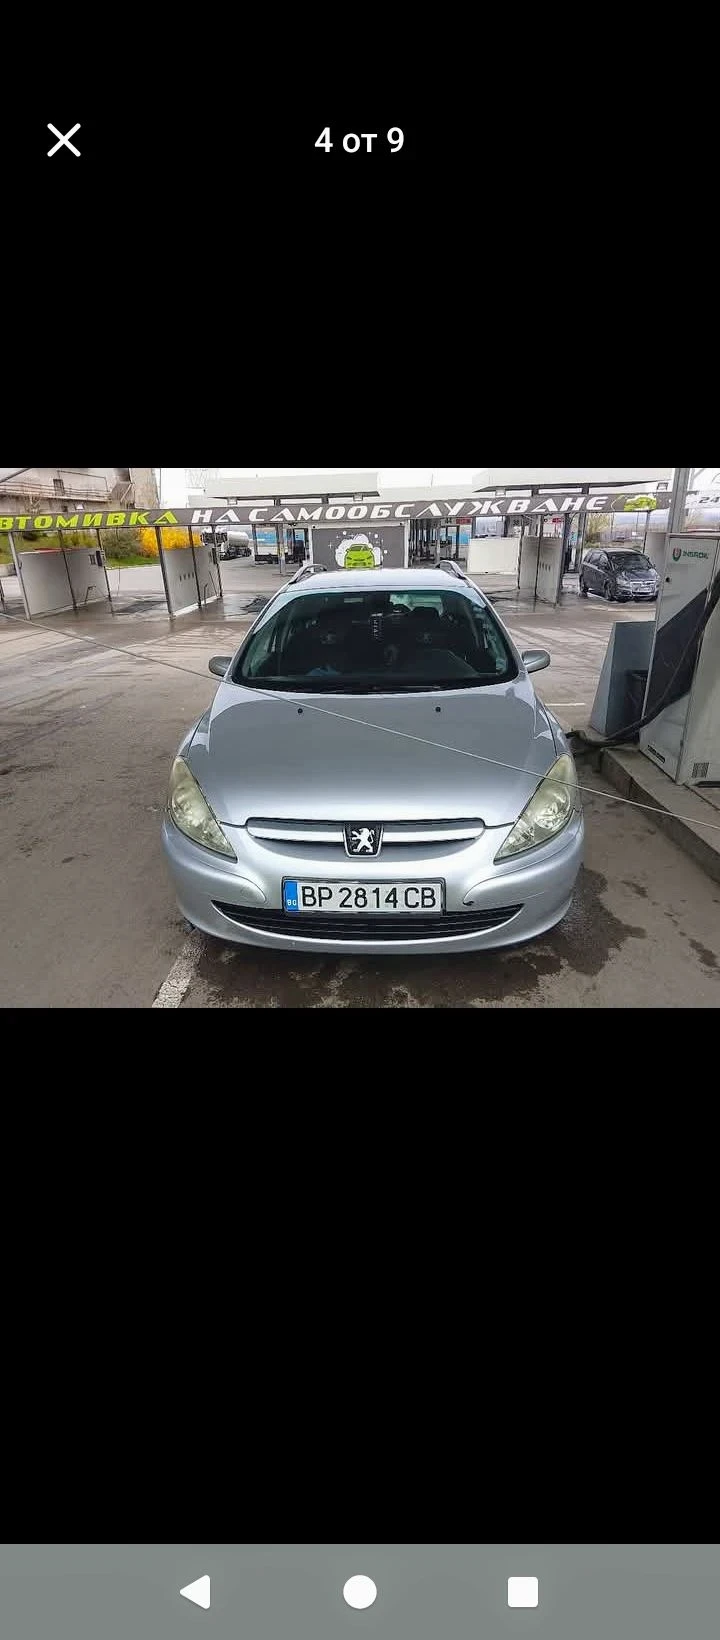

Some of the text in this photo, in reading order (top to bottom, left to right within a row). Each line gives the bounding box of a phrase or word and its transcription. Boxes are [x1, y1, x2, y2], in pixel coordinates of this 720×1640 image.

[191, 508, 241, 524] НА
[248, 495, 609, 522] САМООБСЛУЖВАНЕ
[301, 885, 333, 908] BP
[338, 887, 399, 909] 2814
[404, 887, 437, 909] CB
